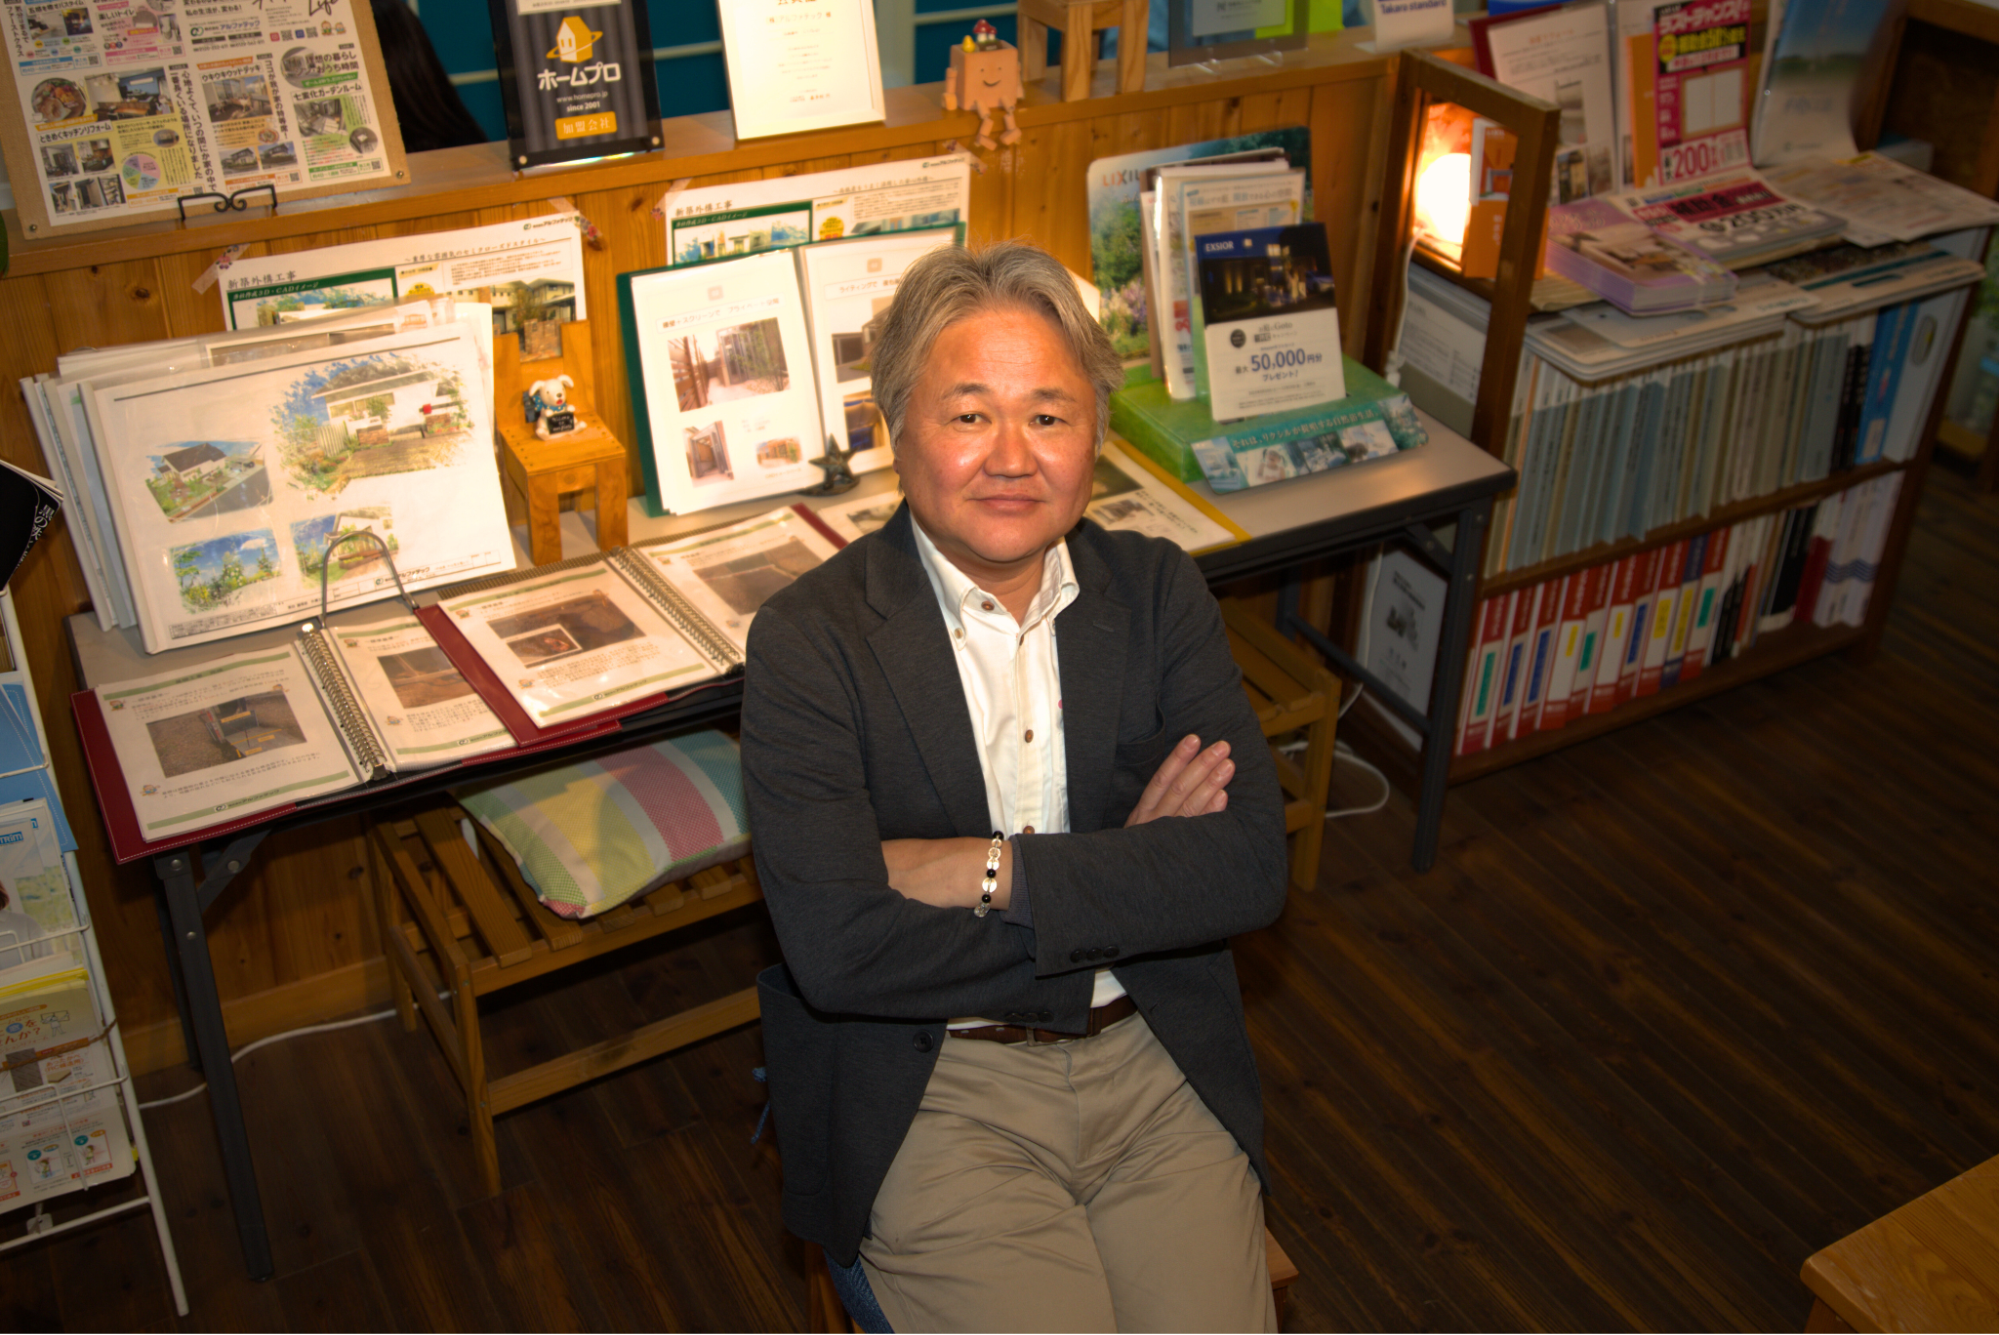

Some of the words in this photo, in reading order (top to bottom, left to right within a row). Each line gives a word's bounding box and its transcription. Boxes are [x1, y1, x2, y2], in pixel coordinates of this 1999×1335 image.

[6, 6, 25, 58] ファーストクラス
[220, 20, 261, 31] アルファテック
[202, 65, 261, 82] ウキウキウッドデッキ
[537, 61, 622, 91] ホームプロ
[556, 90, 609, 104] www.homepro.jp
[566, 103, 584, 112] since
[585, 100, 601, 110] 2001
[39, 123, 111, 144] ときめくキッチンリフォーム
[169, 72, 204, 180] 一番長くいる場所になりました
[563, 117, 611, 135] 加盟会社
[1673, 143, 1709, 178] 200
[1103, 169, 1140, 187] LIXIL
[675, 199, 733, 217] 新築外構工事
[1204, 240, 1235, 253] EXSIOR
[227, 270, 297, 289] 新築外構工事
[1235, 365, 1249, 375] 最大
[1251, 347, 1306, 373] 50,000
[1307, 353, 1323, 364] 円分
[1262, 369, 1299, 382] プレゼント!
